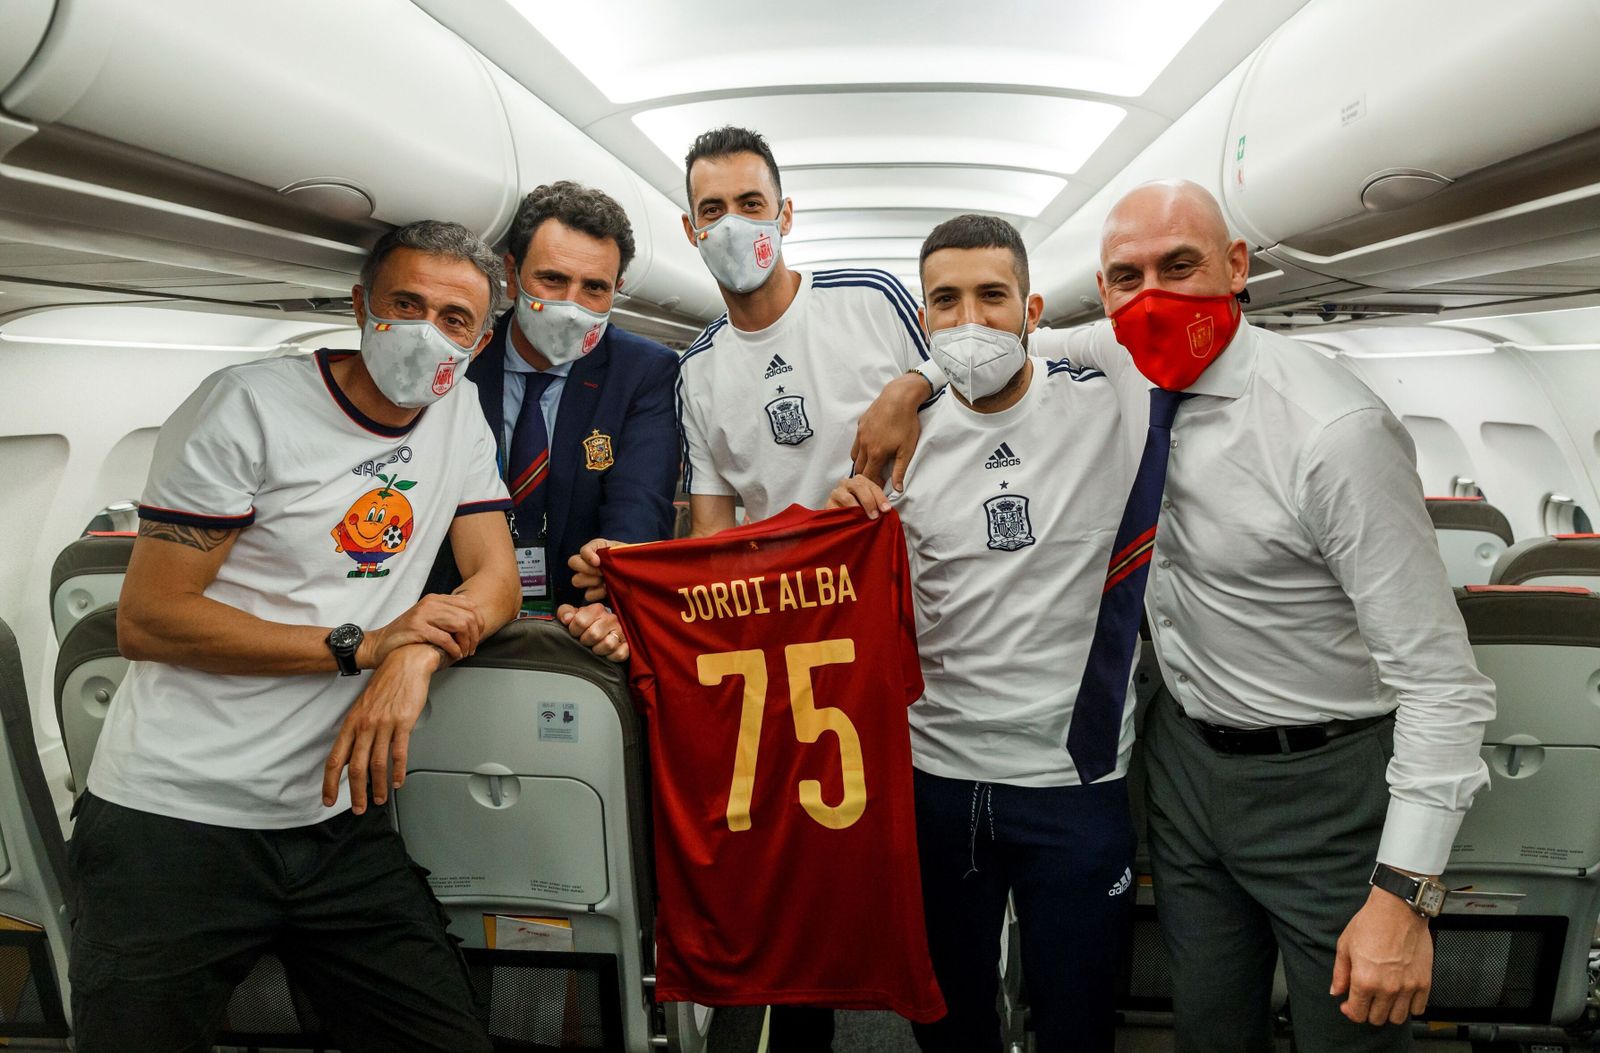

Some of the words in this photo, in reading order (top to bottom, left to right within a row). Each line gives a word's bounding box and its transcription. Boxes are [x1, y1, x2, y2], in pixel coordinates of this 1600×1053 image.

[764, 364, 793, 380] adidas
[985, 457, 1021, 470] adidas
[677, 576, 770, 623] JORDI
[779, 564, 857, 612] ALBA
[696, 638, 867, 832] 75
